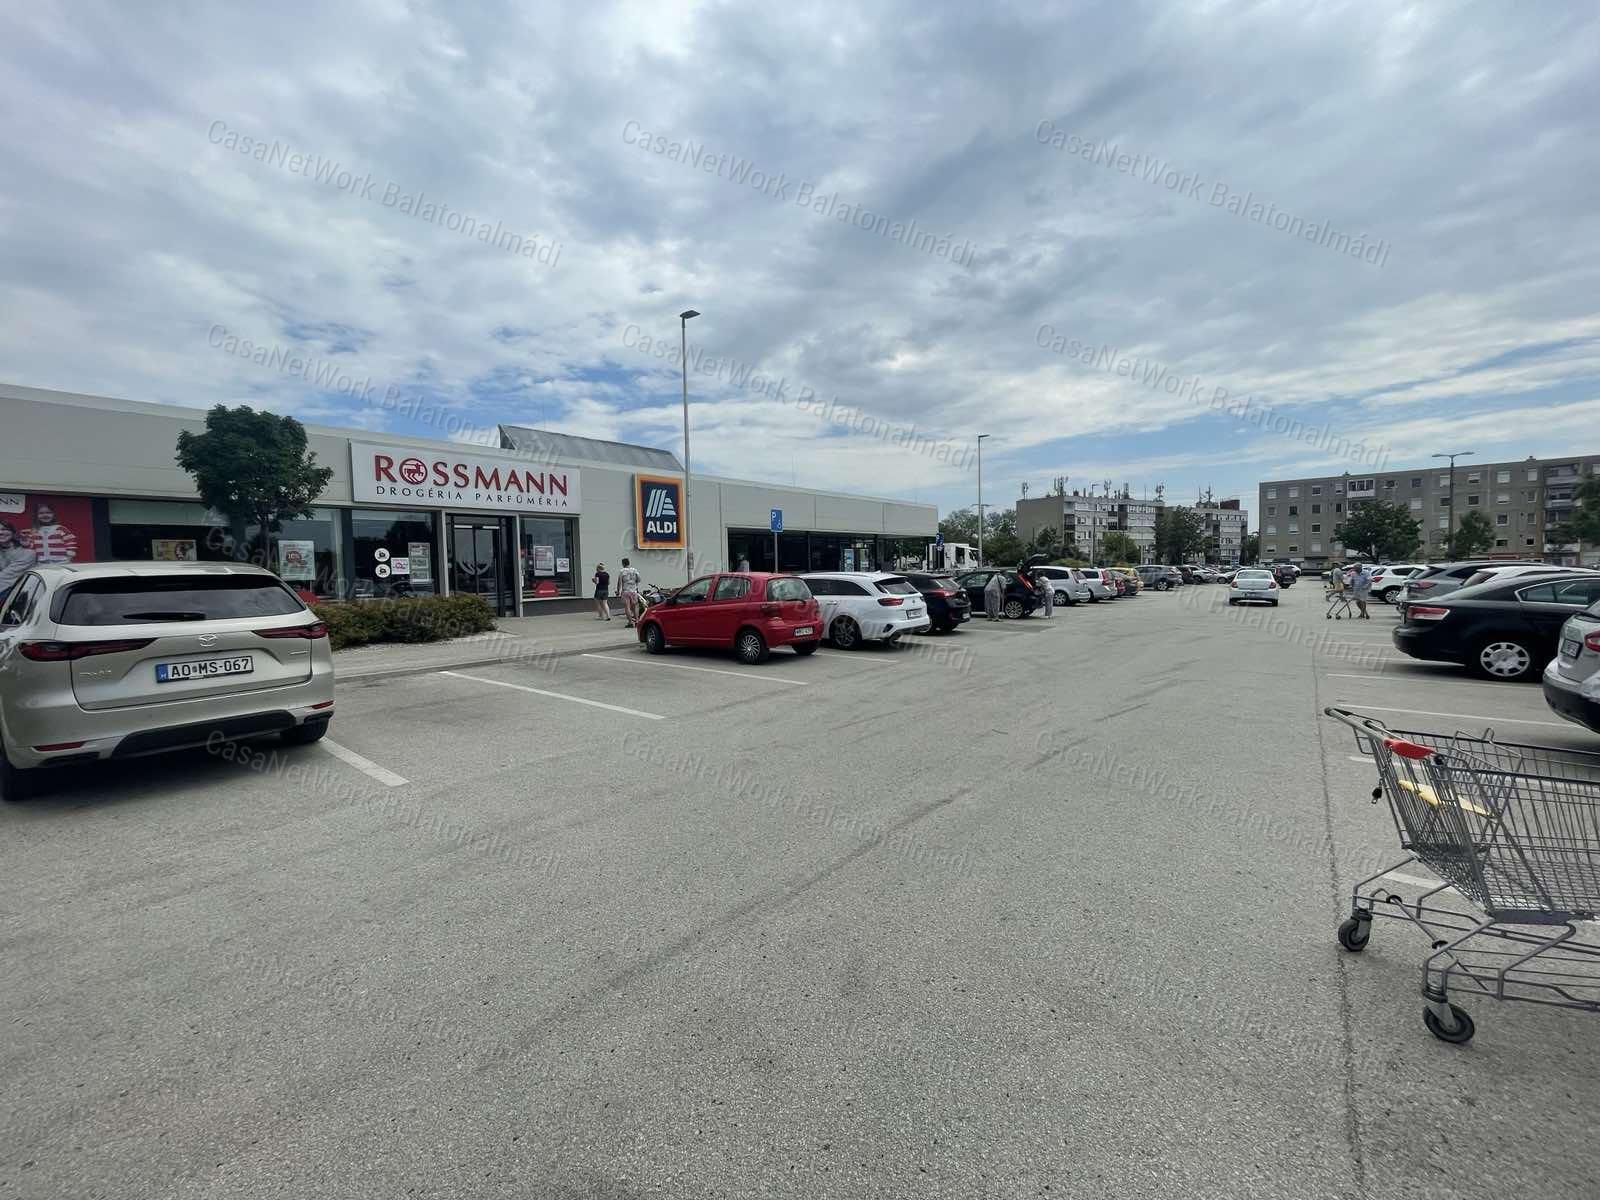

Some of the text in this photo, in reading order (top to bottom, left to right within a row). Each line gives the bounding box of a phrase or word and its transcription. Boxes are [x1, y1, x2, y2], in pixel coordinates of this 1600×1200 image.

[374, 455, 567, 496] ROSSMANN
[376, 485, 463, 500] DROGÉRIA
[646, 520, 677, 534] ALDI
